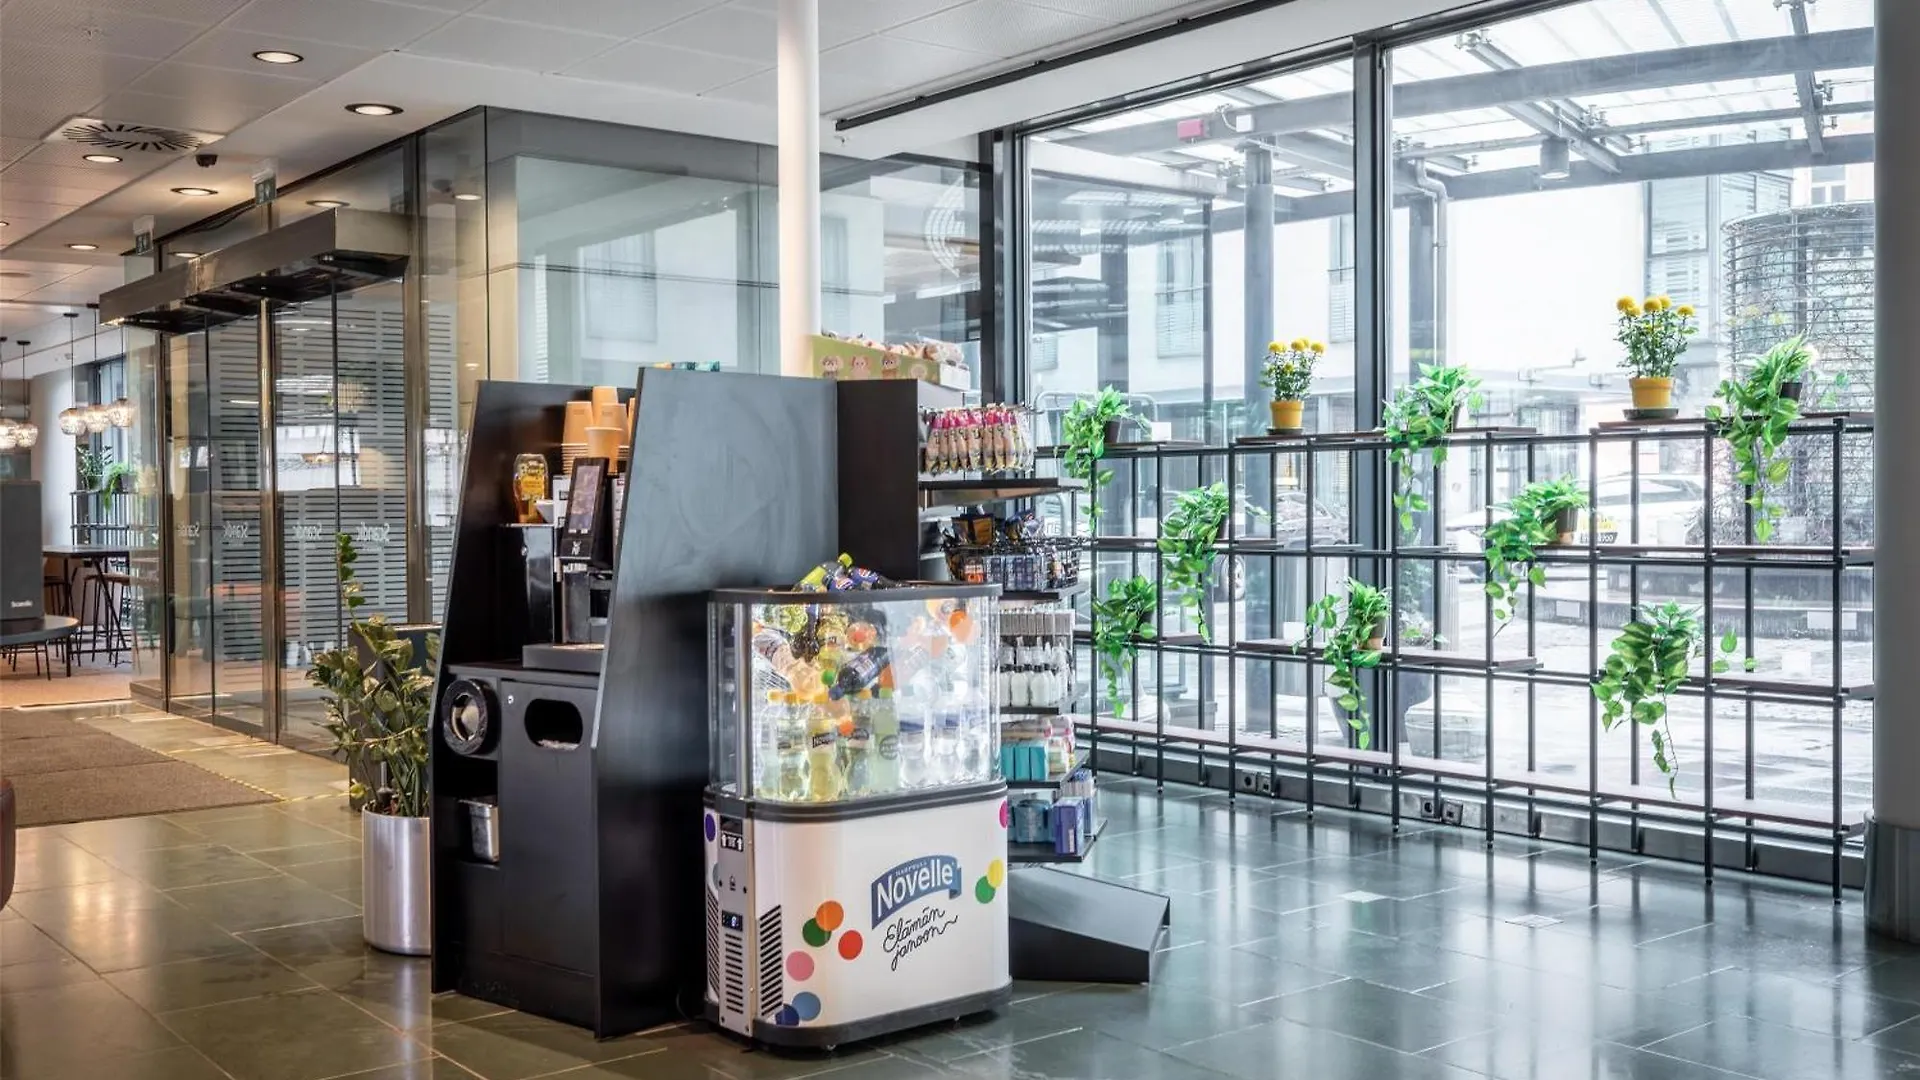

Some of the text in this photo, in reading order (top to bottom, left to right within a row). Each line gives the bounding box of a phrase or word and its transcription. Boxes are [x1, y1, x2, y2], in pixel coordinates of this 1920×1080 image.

[877, 859, 953, 918] Novelle
[883, 906, 945, 953] Elämän
[891, 915, 958, 972] janoon
